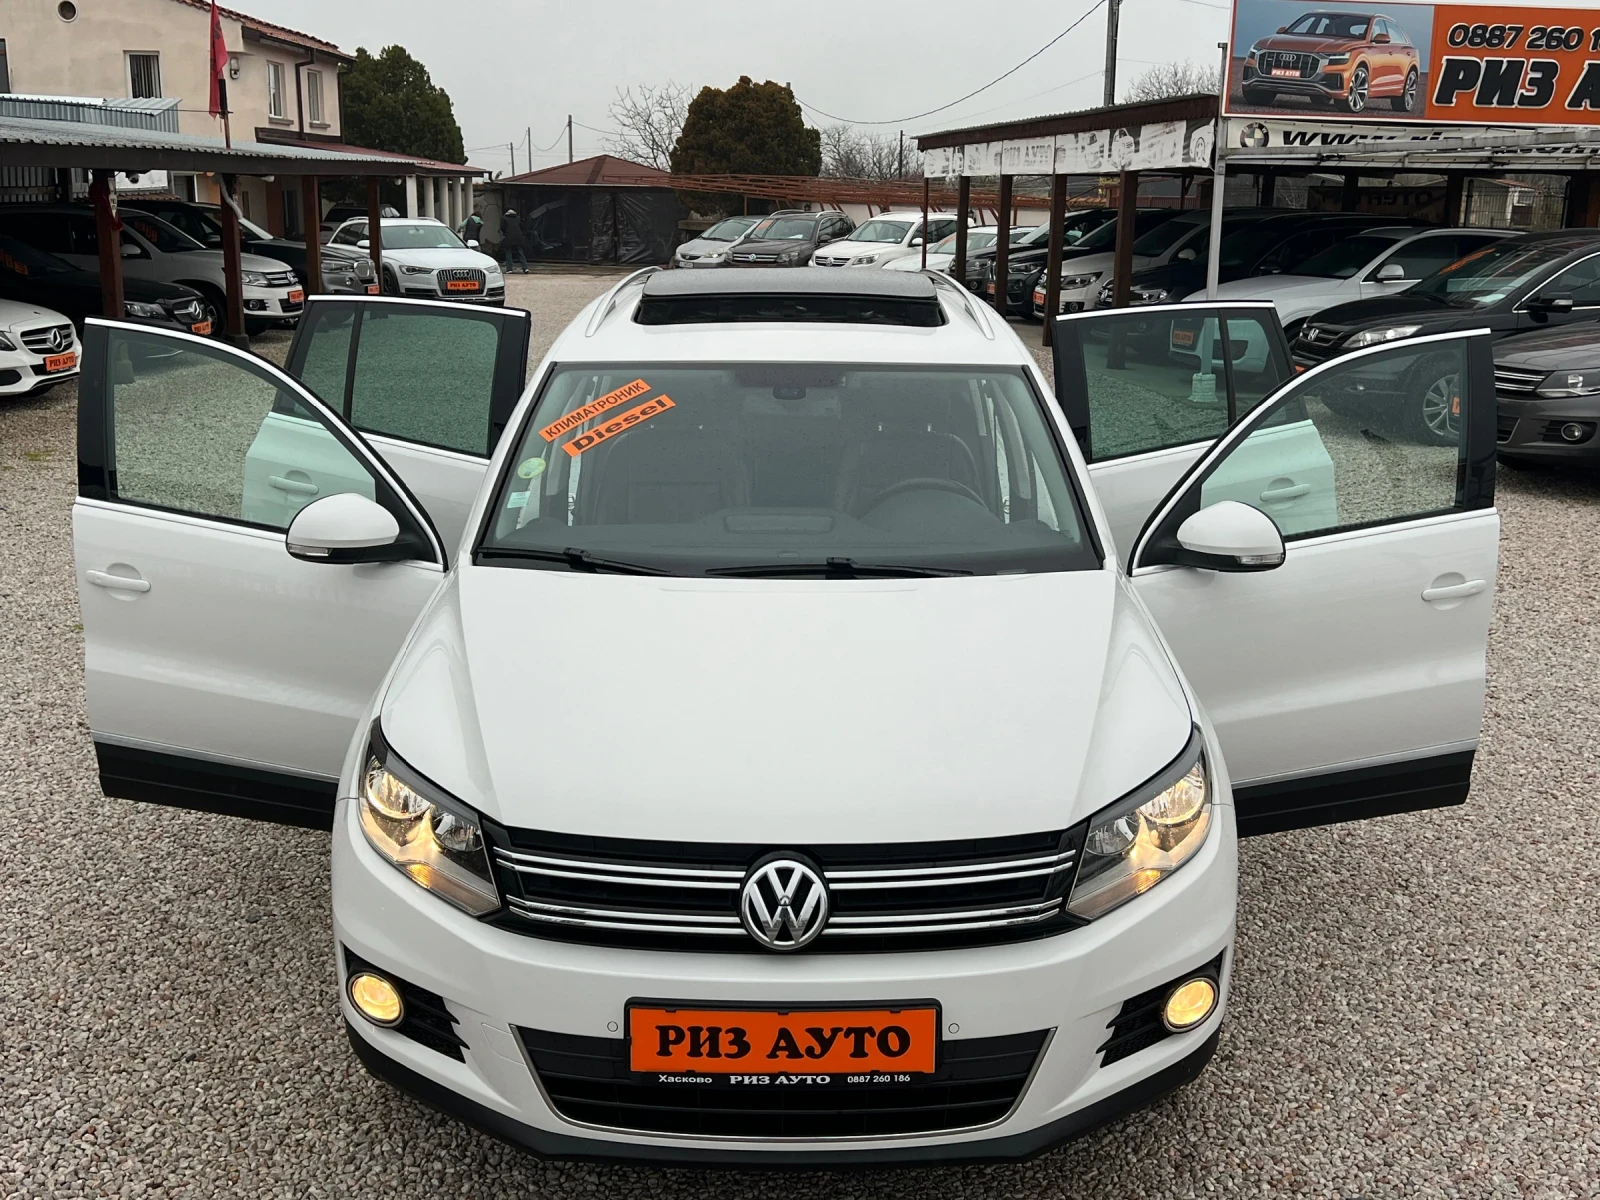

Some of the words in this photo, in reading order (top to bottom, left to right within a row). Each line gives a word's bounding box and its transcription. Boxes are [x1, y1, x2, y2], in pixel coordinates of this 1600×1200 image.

[1447, 23, 1524, 51] 0887
[1525, 25, 1584, 51] 260
[1589, 27, 1600, 52] 1
[1433, 56, 1560, 109] РИЗ
[49, 358, 61, 368] РИЗ
[62, 355, 75, 365] АУТО
[545, 382, 645, 438] КЛИМАТРОНИК
[571, 398, 668, 451] Diesel
[655, 1025, 751, 1059] РИЗ
[765, 1025, 911, 1060] АУТО
[658, 1074, 713, 1084] Хасково
[729, 1075, 771, 1086] РИЗ
[775, 1075, 831, 1085] АУТО
[847, 1075, 871, 1084] 0887
[873, 1074, 891, 1083] 260
[894, 1074, 911, 1083] 186
